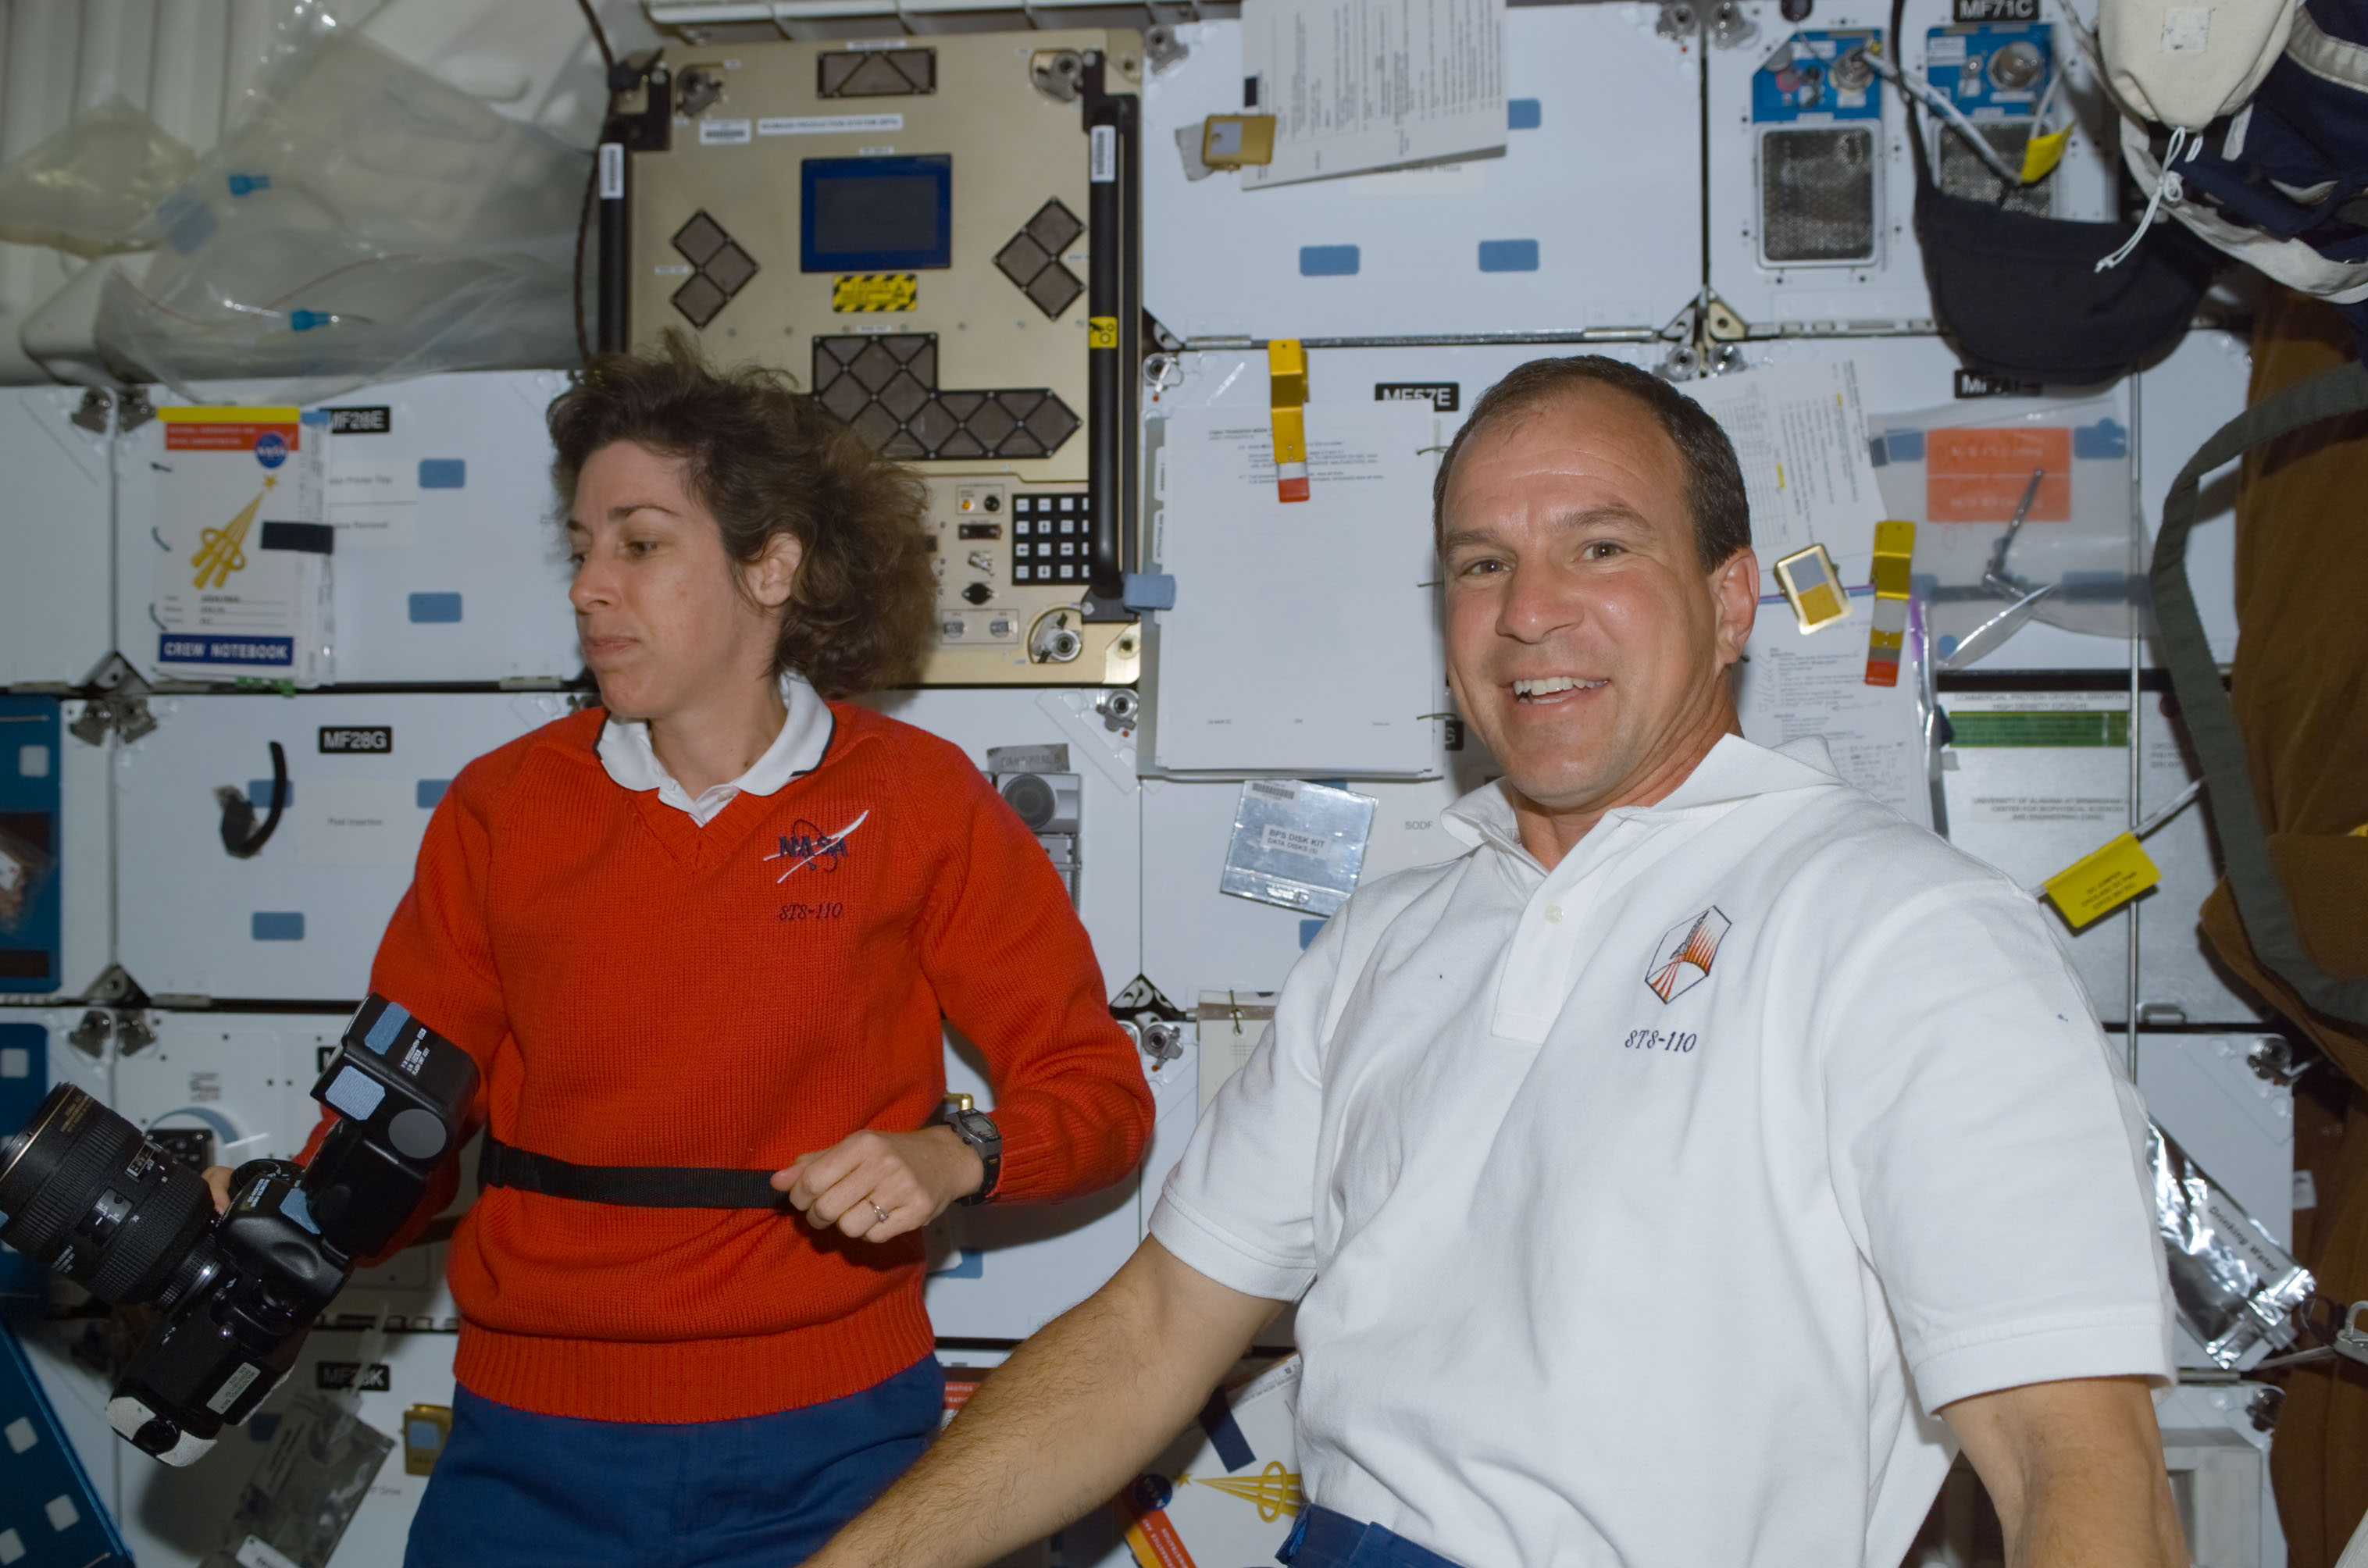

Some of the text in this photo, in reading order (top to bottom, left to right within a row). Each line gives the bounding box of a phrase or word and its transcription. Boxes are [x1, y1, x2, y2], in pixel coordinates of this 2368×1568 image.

[1960, 0, 2035, 18] MF71C
[164, 642, 288, 660] CREW NOTEBOOK
[323, 730, 387, 750] MF28G
[1405, 821, 1433, 830] SODF
[779, 835, 849, 858] NASA
[1267, 837, 1286, 848] DATA
[1269, 829, 1325, 849] BPS DISK KIT
[779, 902, 844, 920] STS-110
[1624, 1029, 1698, 1053] STS-110
[130, 1214, 140, 1224] 70
[2209, 1206, 2278, 1272] Drinking Water
[323, 1367, 384, 1387] MF2K
